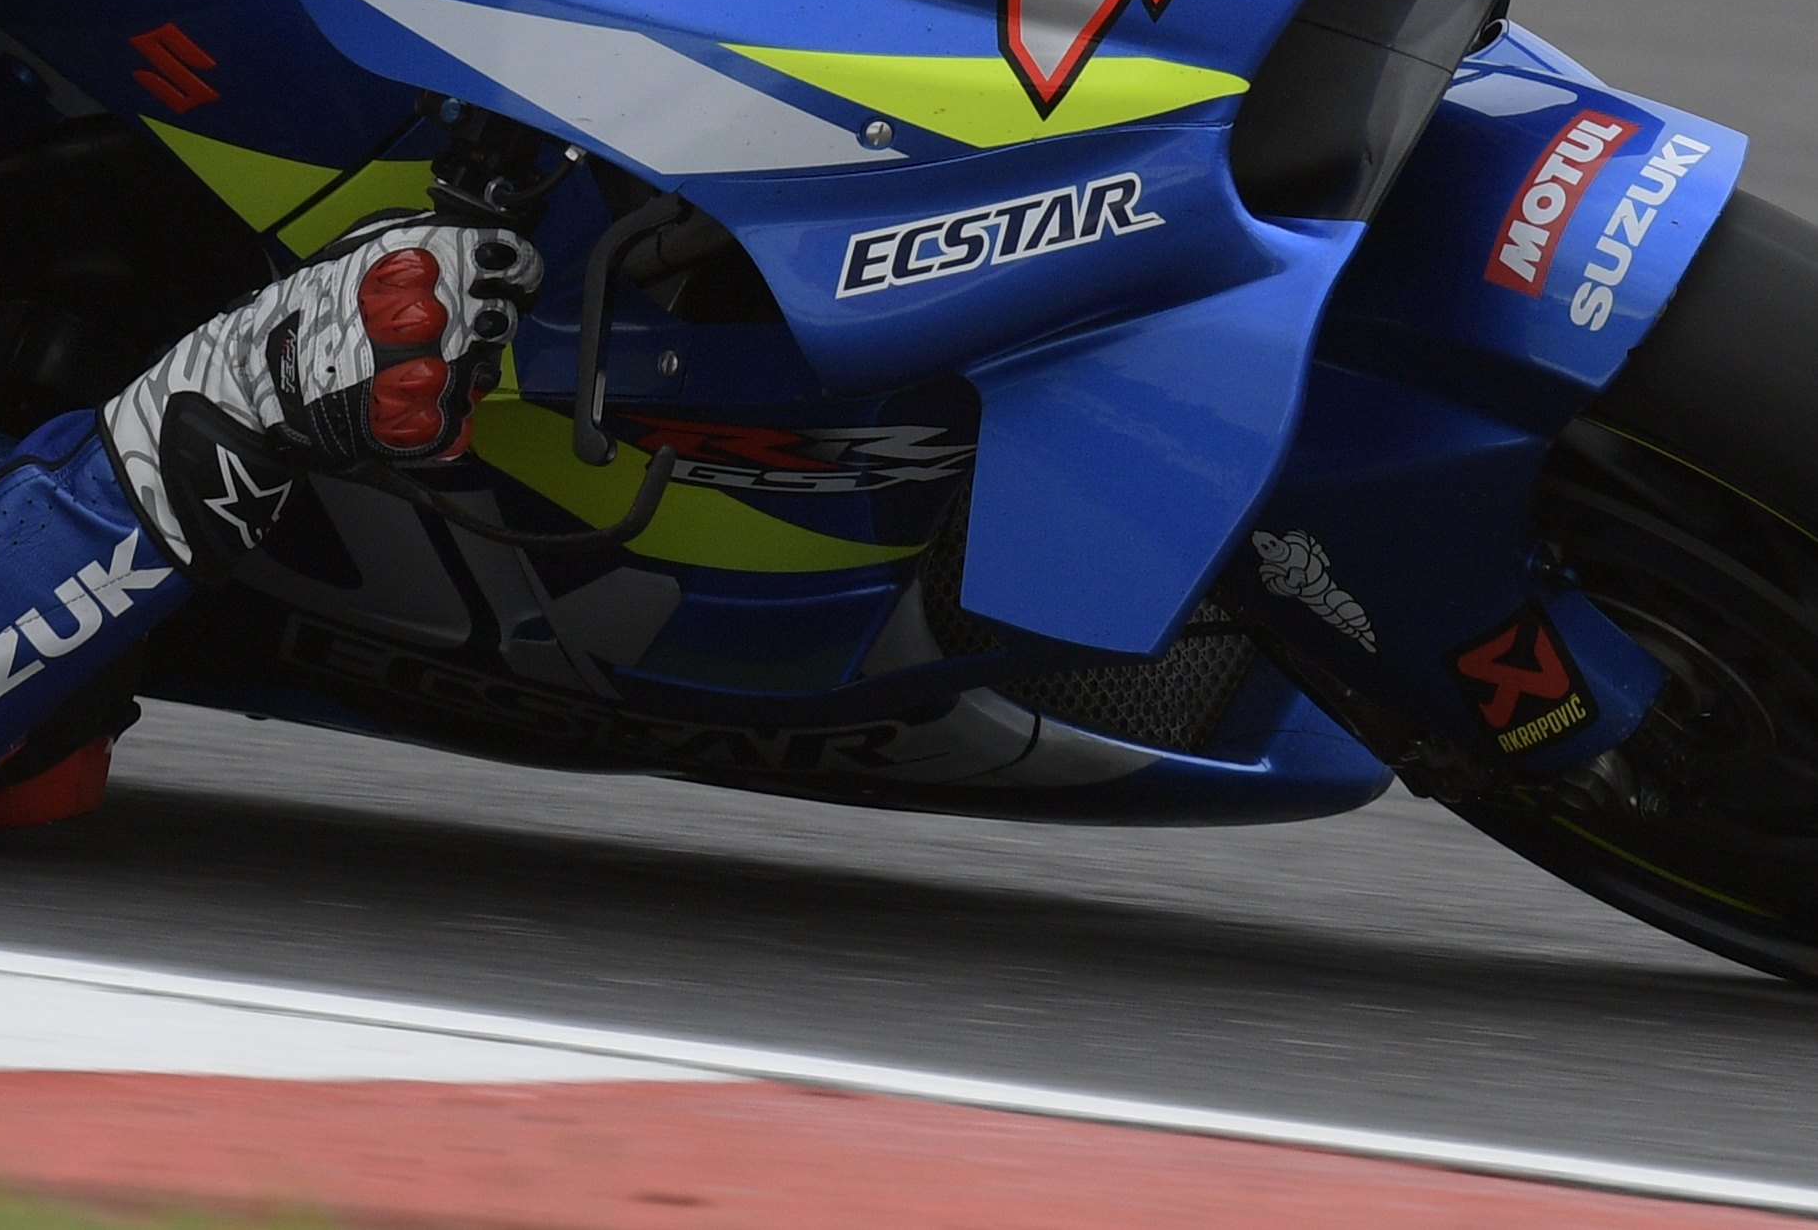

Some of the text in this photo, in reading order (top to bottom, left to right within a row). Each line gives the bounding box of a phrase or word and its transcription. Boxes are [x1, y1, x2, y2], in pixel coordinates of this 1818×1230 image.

[835, 171, 1167, 300] ECSTAR
[1499, 119, 1624, 284] MOTUL
[1569, 133, 1712, 332] SUZUKI
[1496, 691, 1588, 754] AKRAPOVIČ
